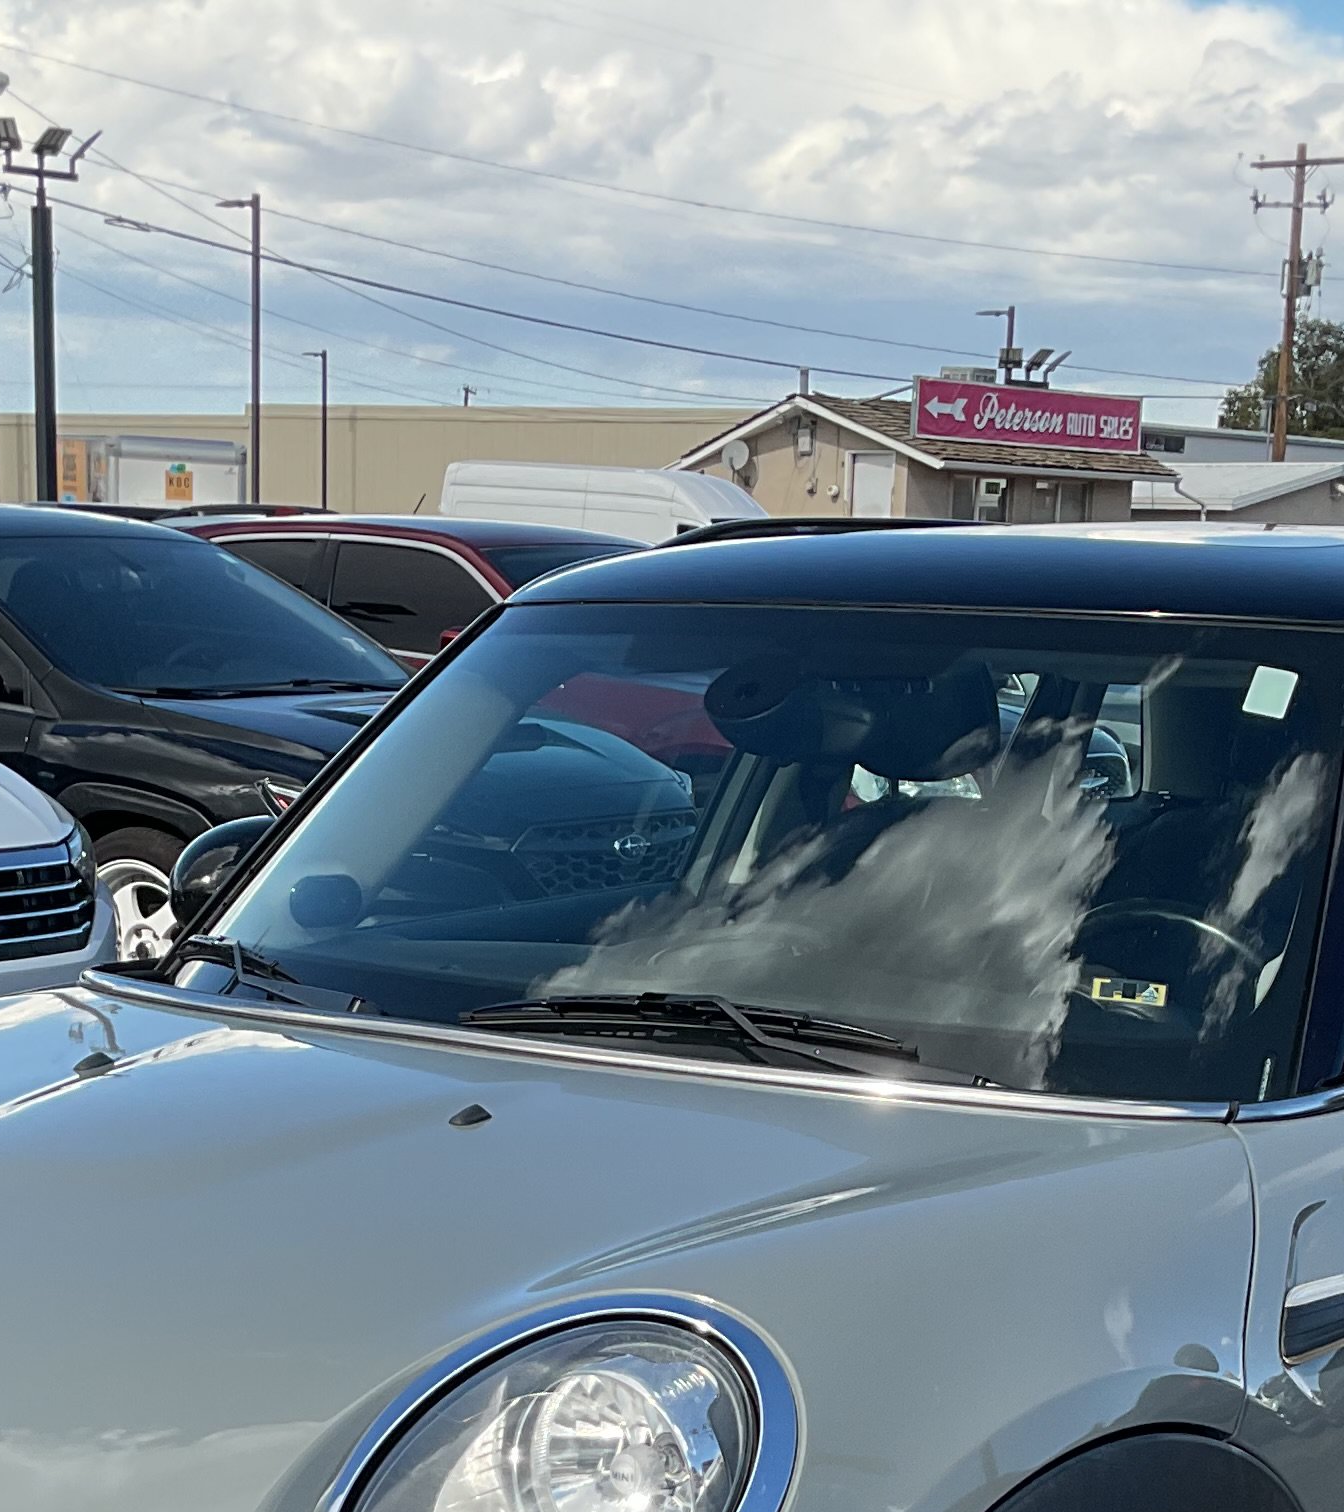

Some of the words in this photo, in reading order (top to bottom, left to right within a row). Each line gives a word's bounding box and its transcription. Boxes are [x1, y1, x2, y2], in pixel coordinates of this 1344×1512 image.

[973, 391, 1064, 433] Peterson
[1067, 412, 1096, 437] AUTO
[1099, 415, 1134, 440] SALES
